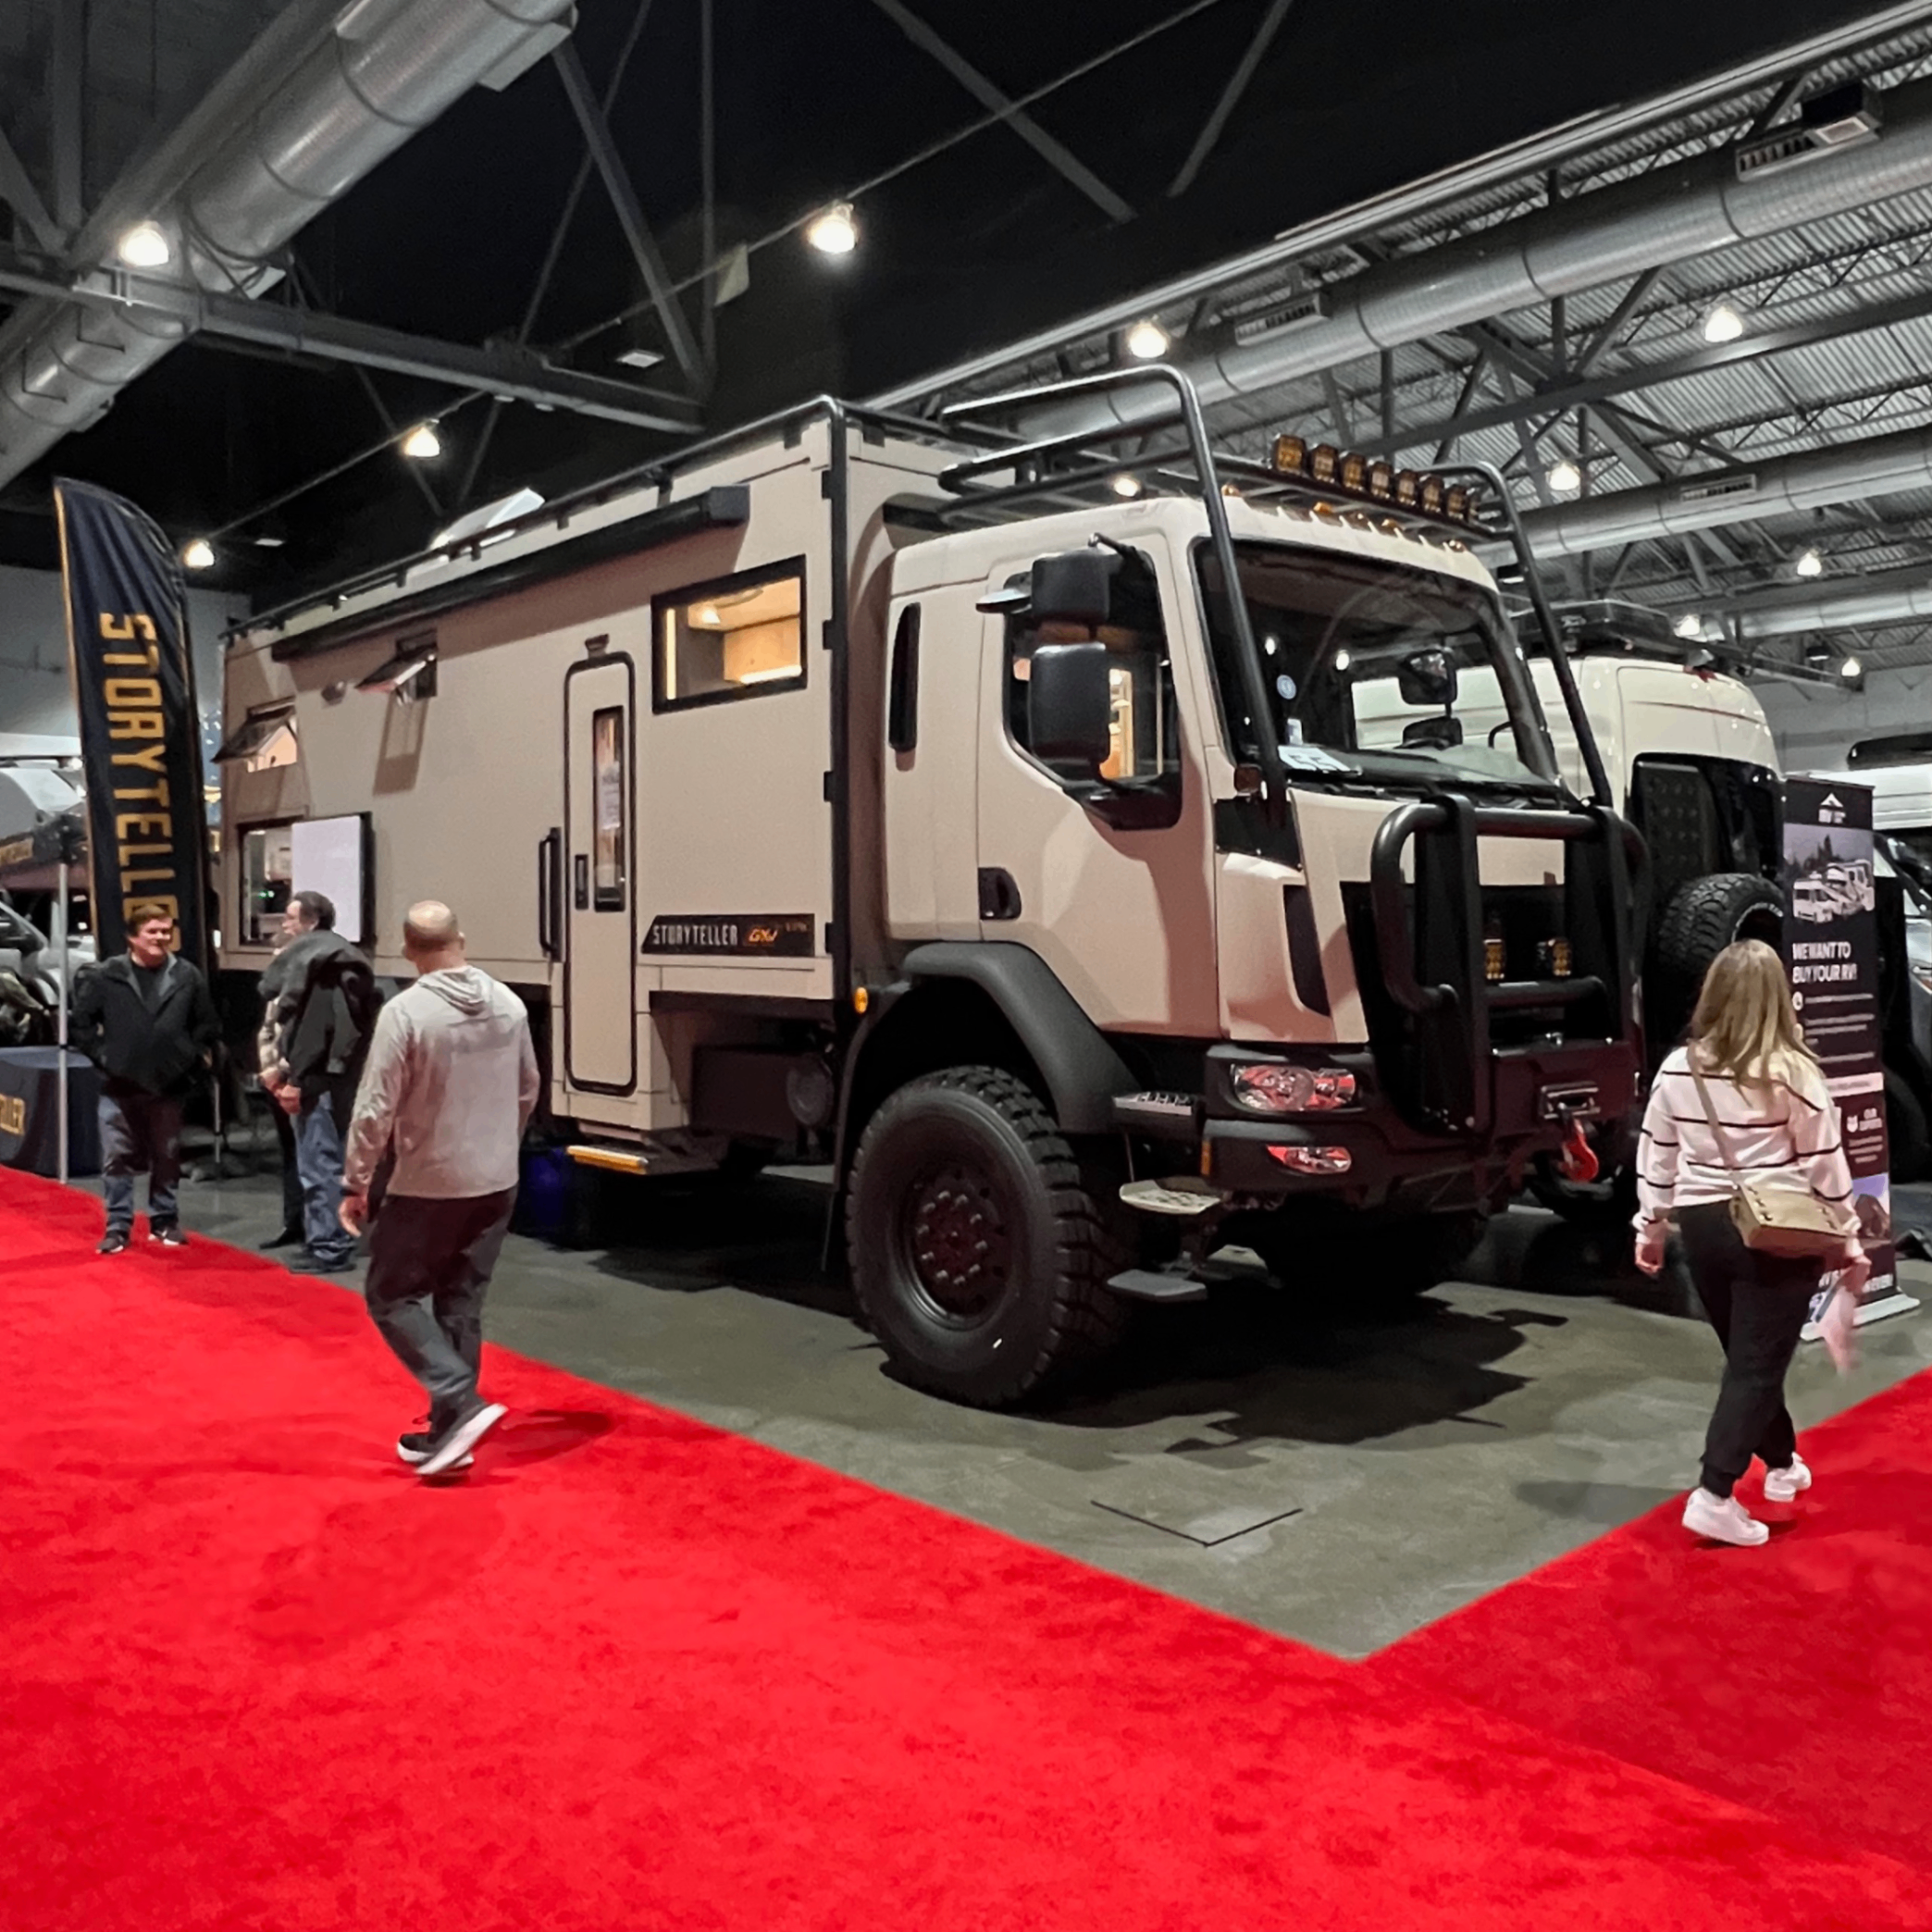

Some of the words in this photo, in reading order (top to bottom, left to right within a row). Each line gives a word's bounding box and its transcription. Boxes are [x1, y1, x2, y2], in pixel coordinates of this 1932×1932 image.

[99, 612, 181, 952] STORYTELLE
[653, 924, 737, 946] STORYTELLER
[1792, 942, 1809, 960] WE
[1809, 941, 1836, 959] WANT
[1837, 940, 1852, 959] TO
[1792, 966, 1812, 985] BUY
[1811, 964, 1840, 983] YOUR
